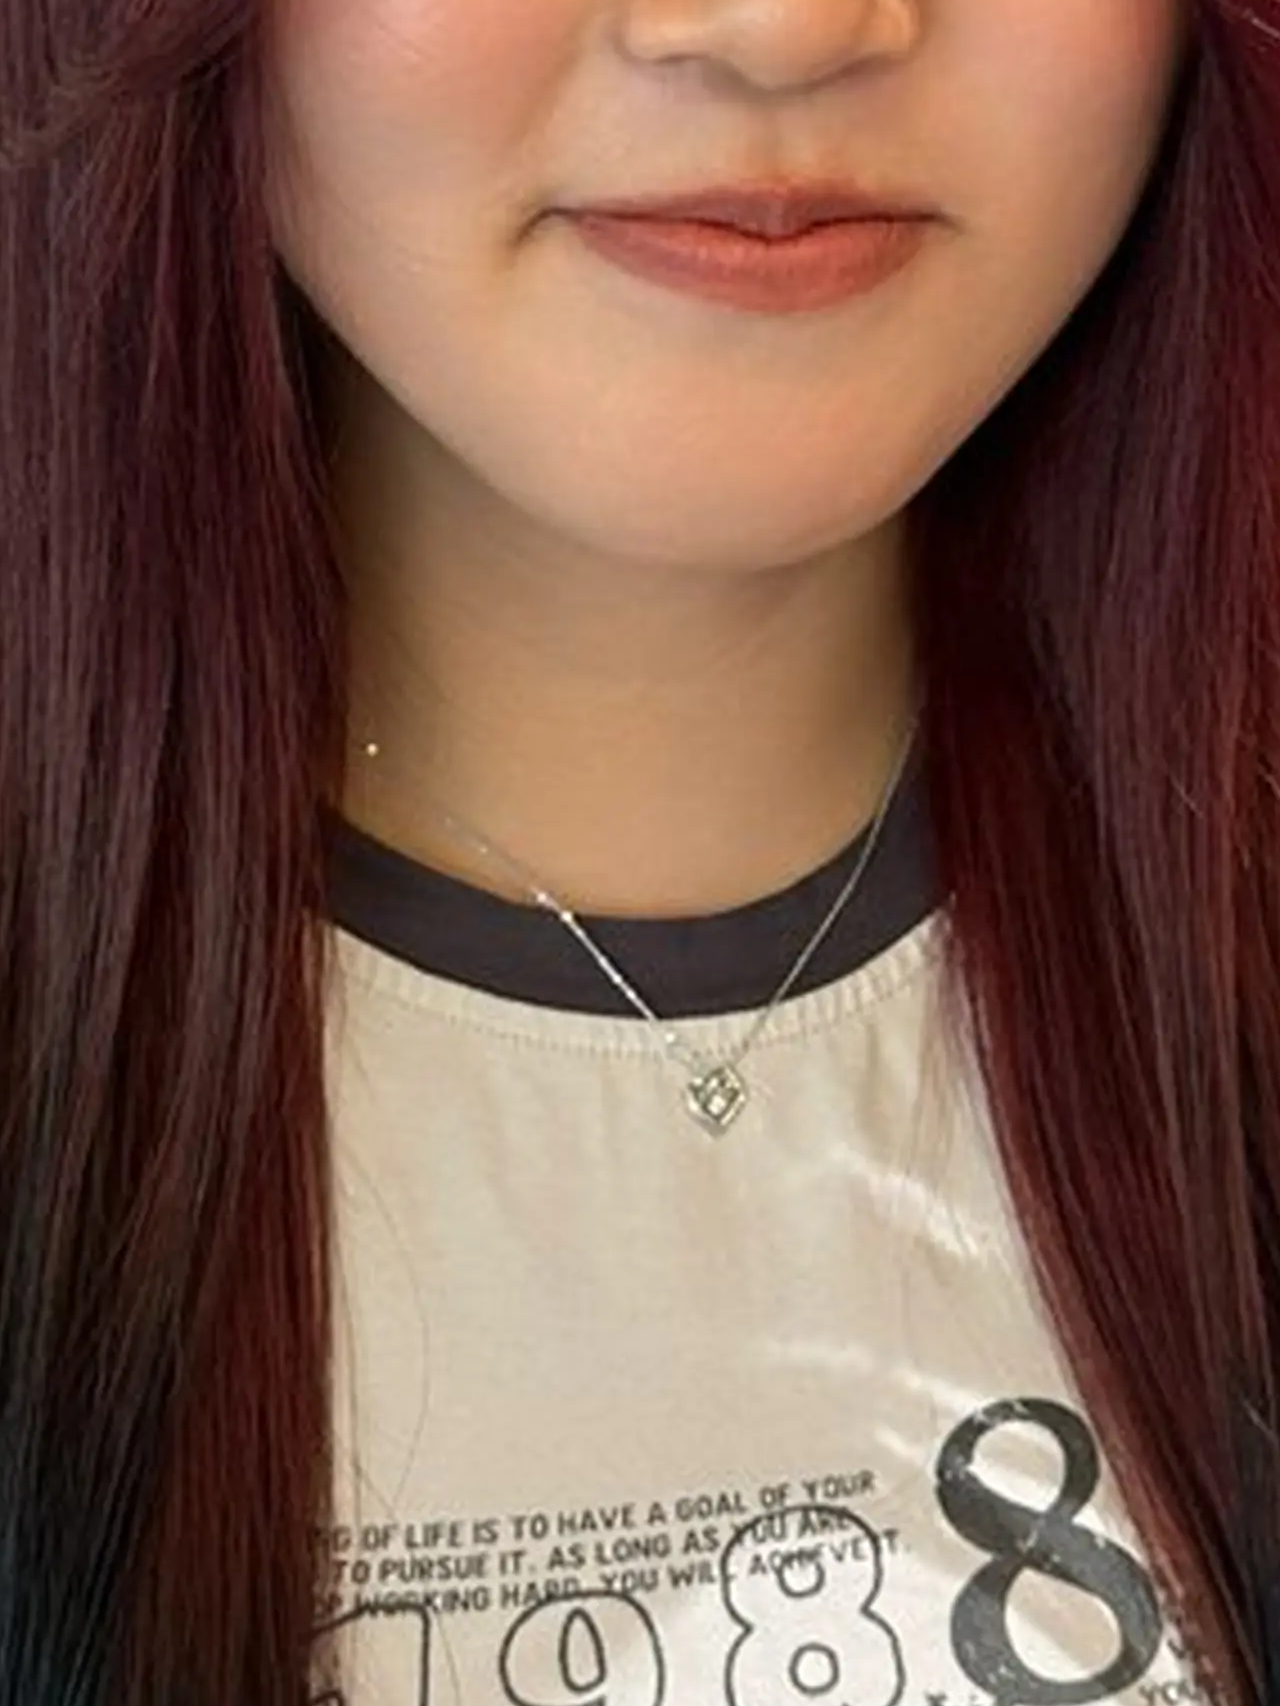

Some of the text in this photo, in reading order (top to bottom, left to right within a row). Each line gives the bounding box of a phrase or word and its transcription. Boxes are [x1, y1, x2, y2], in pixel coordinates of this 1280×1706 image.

[362, 1525, 395, 1552] OF
[405, 1521, 462, 1550] LIFE
[473, 1518, 501, 1544] IS
[507, 1513, 549, 1541] TO
[558, 1505, 636, 1534] HAVE
[646, 1500, 668, 1525] A
[674, 1492, 748, 1522] GOAL
[759, 1482, 791, 1509] OF
[801, 1469, 878, 1500] YOUR
[378, 1550, 486, 1585] PURSUE
[546, 1543, 587, 1573] AS
[594, 1534, 672, 1566] LONG
[682, 1527, 722, 1557] AS
[600, 1569, 659, 1595] YOU
